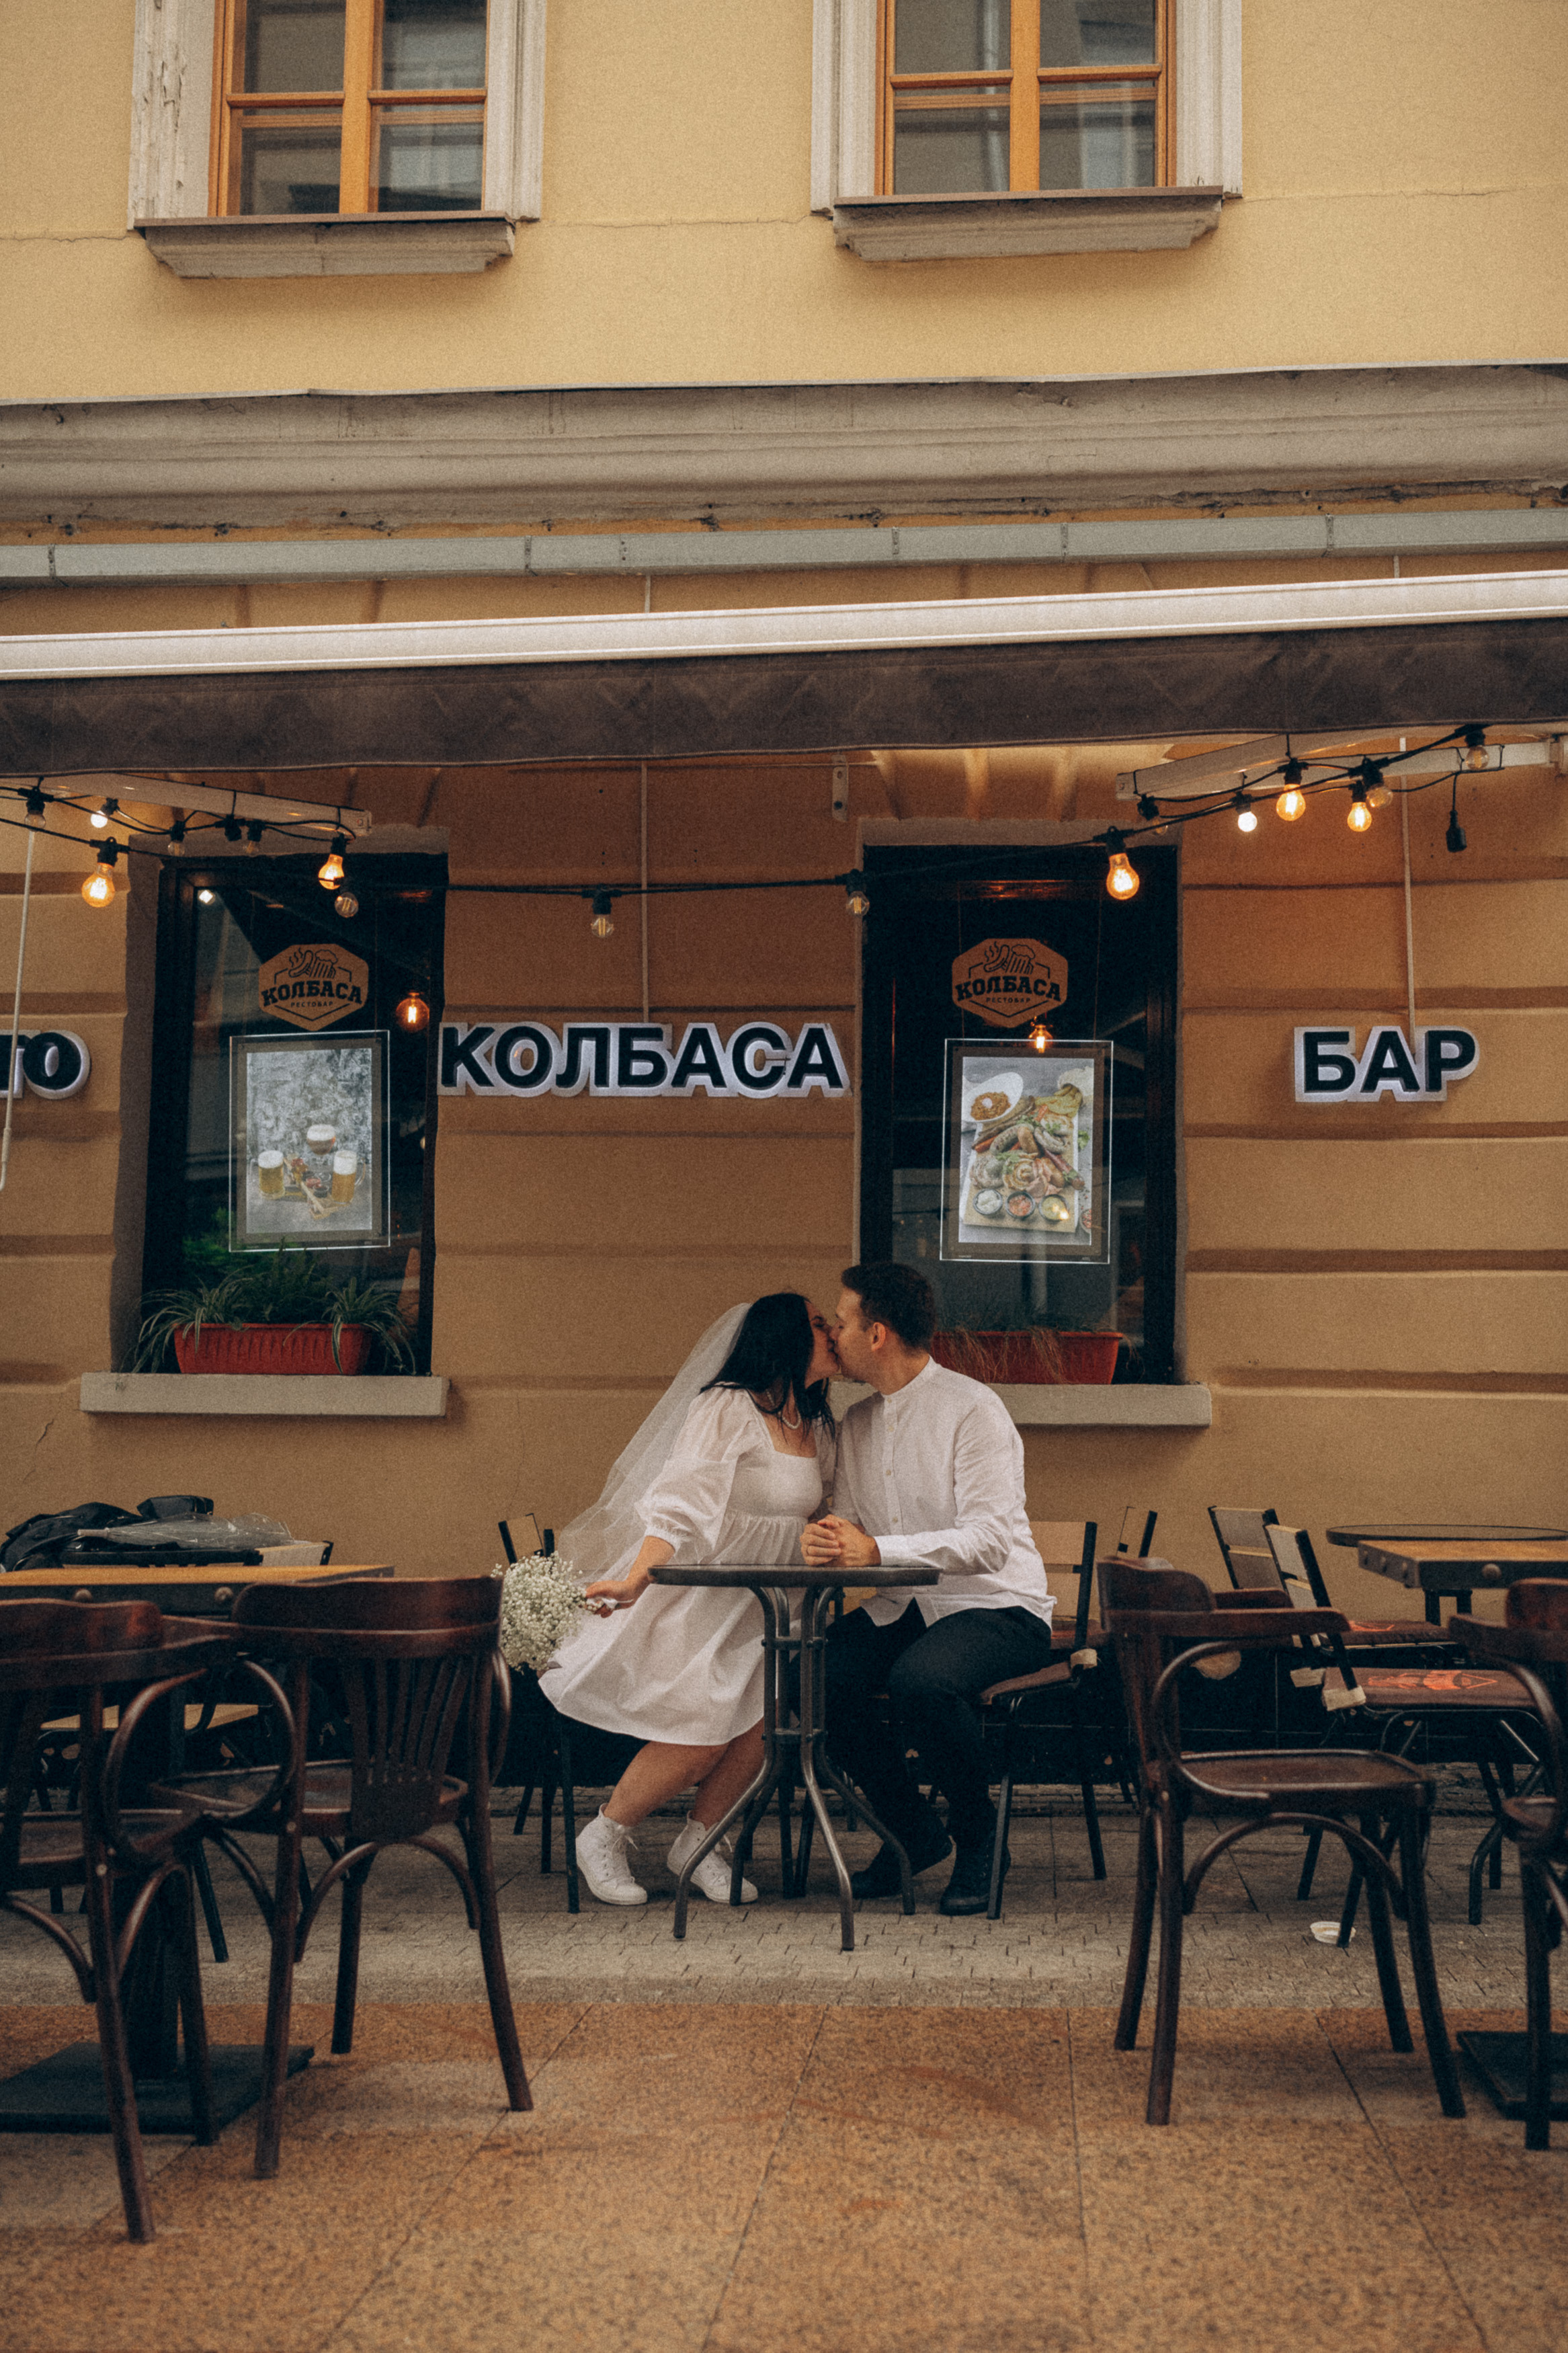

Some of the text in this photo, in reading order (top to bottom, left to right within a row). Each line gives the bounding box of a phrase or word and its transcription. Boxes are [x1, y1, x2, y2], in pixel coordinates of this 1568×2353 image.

[261, 980, 362, 1007] КОЛБАСА
[955, 975, 1061, 1002] КОЛБАСА
[441, 1026, 845, 1090] КОЛБАСА
[1303, 1030, 1475, 1093] БАР
